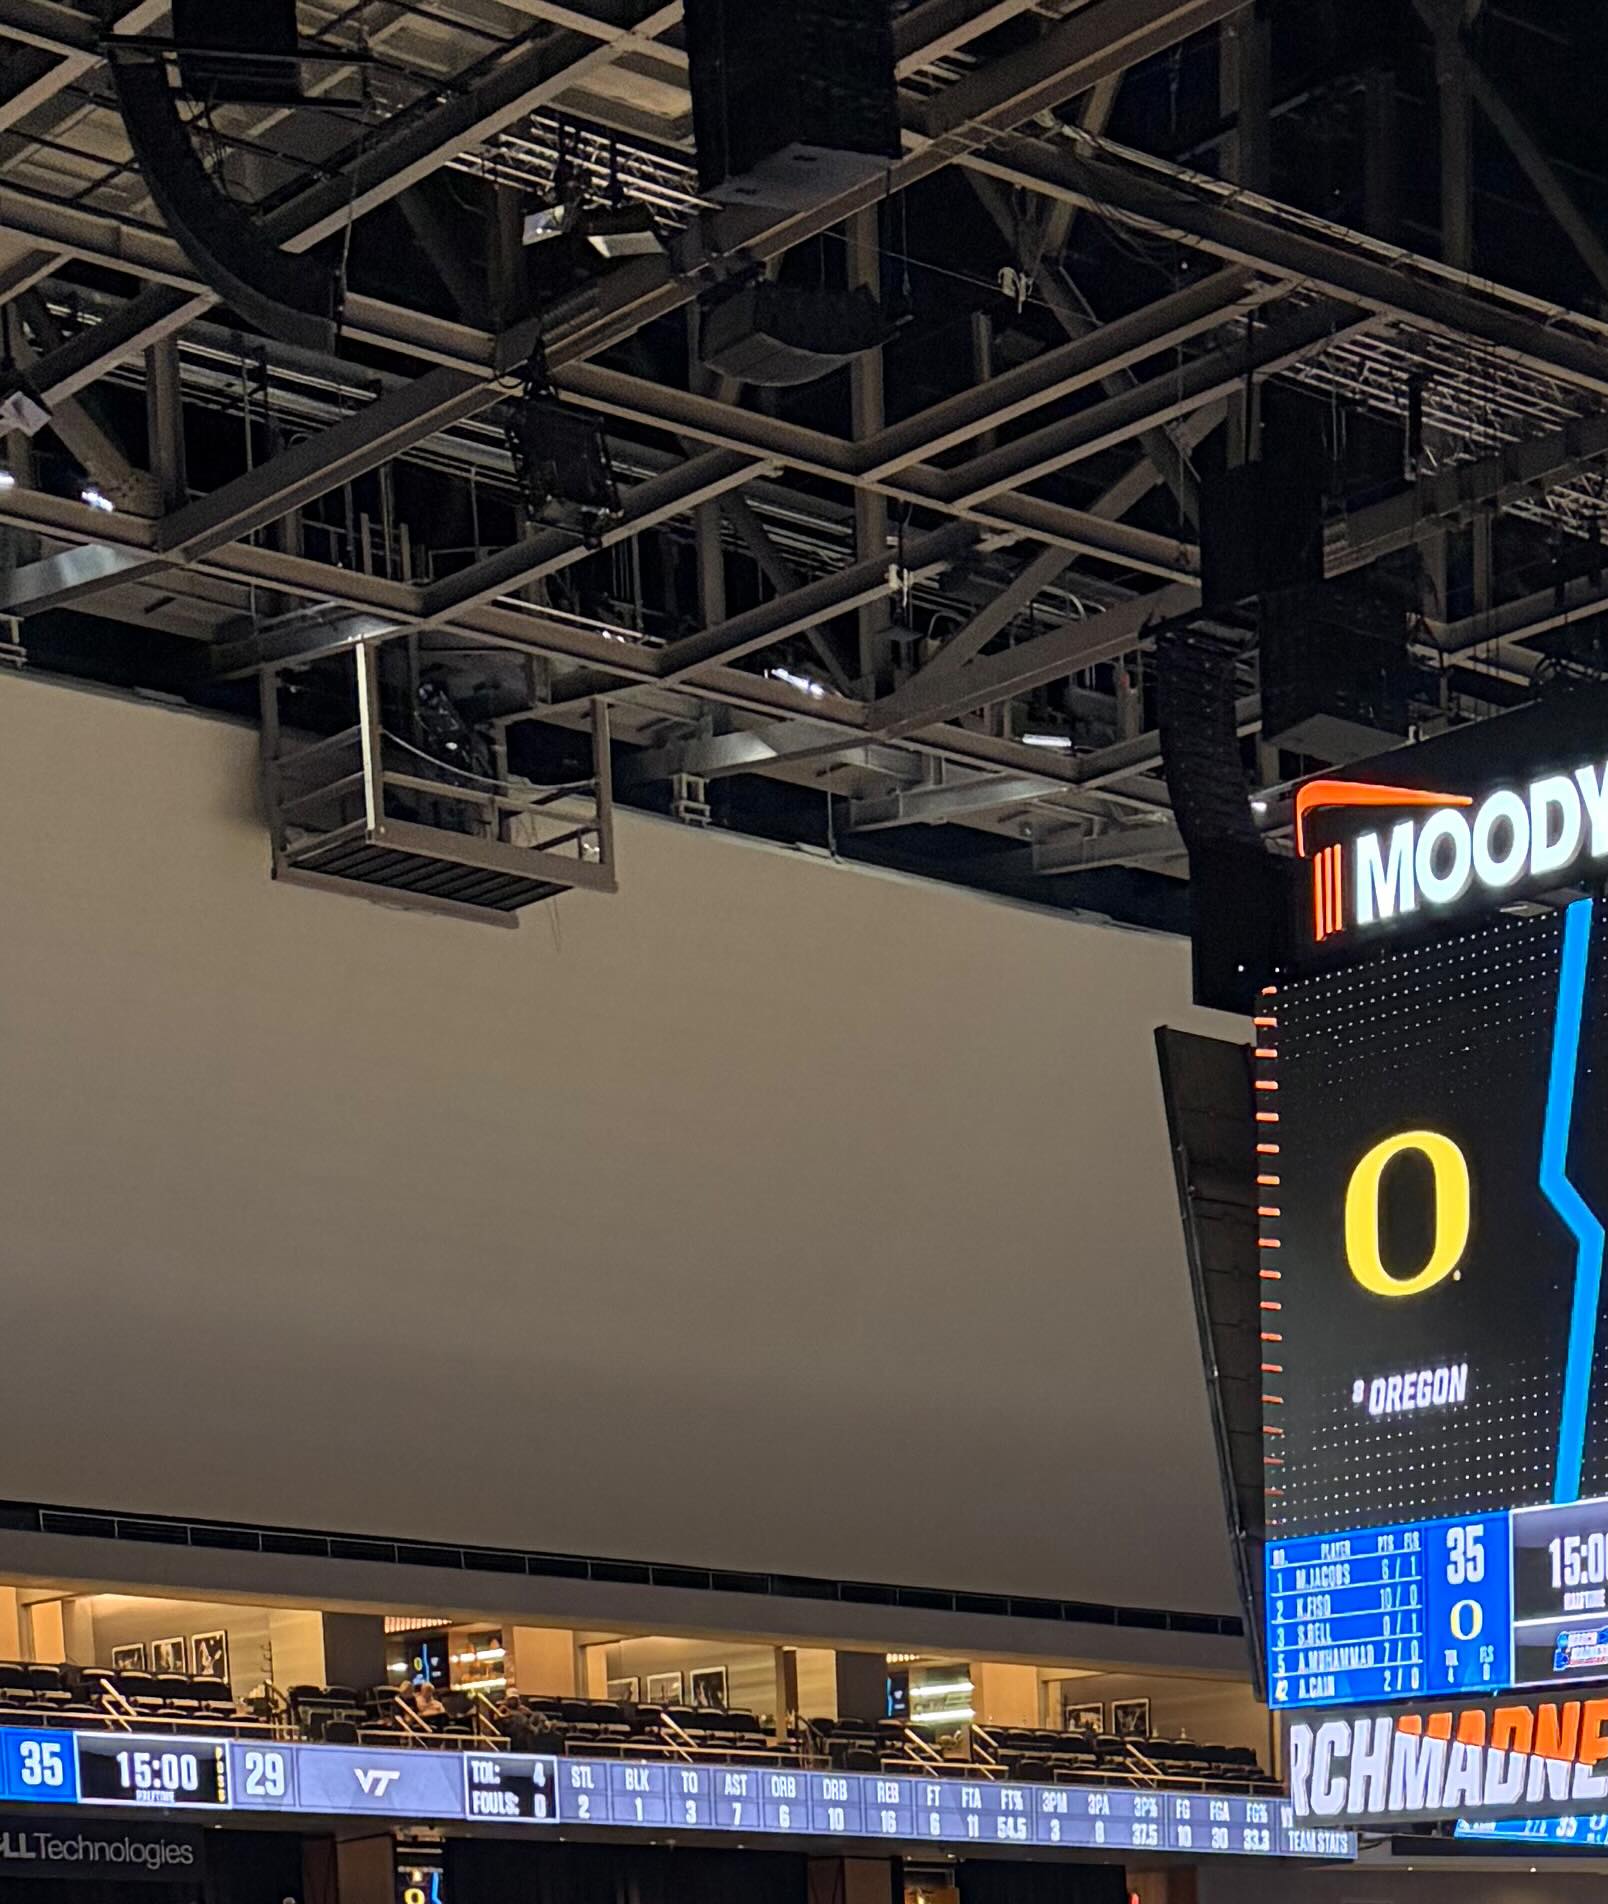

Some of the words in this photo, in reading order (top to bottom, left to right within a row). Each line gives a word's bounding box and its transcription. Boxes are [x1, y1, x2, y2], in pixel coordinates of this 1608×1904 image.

[1345, 1129, 1470, 1296] O
[1352, 1378, 1364, 1404] 8
[1368, 1363, 1469, 1416] OREGON
[1446, 1523, 1485, 1585] 35
[20, 1741, 63, 1786] 35
[116, 1751, 199, 1790] 15:00
[245, 1752, 285, 1796] 29
[354, 1768, 400, 1797] VT
[471, 1761, 500, 1785] TOL:
[533, 1762, 545, 1787] 4
[472, 1791, 519, 1816] FOULS:
[534, 1793, 546, 1817] 0
[571, 1766, 594, 1789] STL
[625, 1767, 649, 1792] BLK
[681, 1771, 697, 1794] TO
[725, 1774, 747, 1796] AST
[771, 1775, 796, 1798] ORB
[823, 1778, 847, 1801] DRB
[877, 1781, 899, 1804] REB
[927, 1785, 940, 1807] FT
[961, 1787, 981, 1809] FTA
[1042, 1791, 1068, 1814] 3PM
[1088, 1794, 1109, 1815] 3PA
[1176, 1799, 1190, 1820] FG
[1210, 1801, 1230, 1822] FGA
[578, 1795, 590, 1819] 2
[635, 1797, 642, 1821] 1
[685, 1800, 697, 1824] 3
[732, 1803, 741, 1826] 7
[828, 1808, 844, 1831] 10
[967, 1815, 979, 1838] 11
[1051, 1819, 1060, 1842] 3
[34, 1832, 193, 1869] Technologies
[1288, 1830, 1316, 1852] TEAM
[1317, 1831, 1348, 1854] STATS
